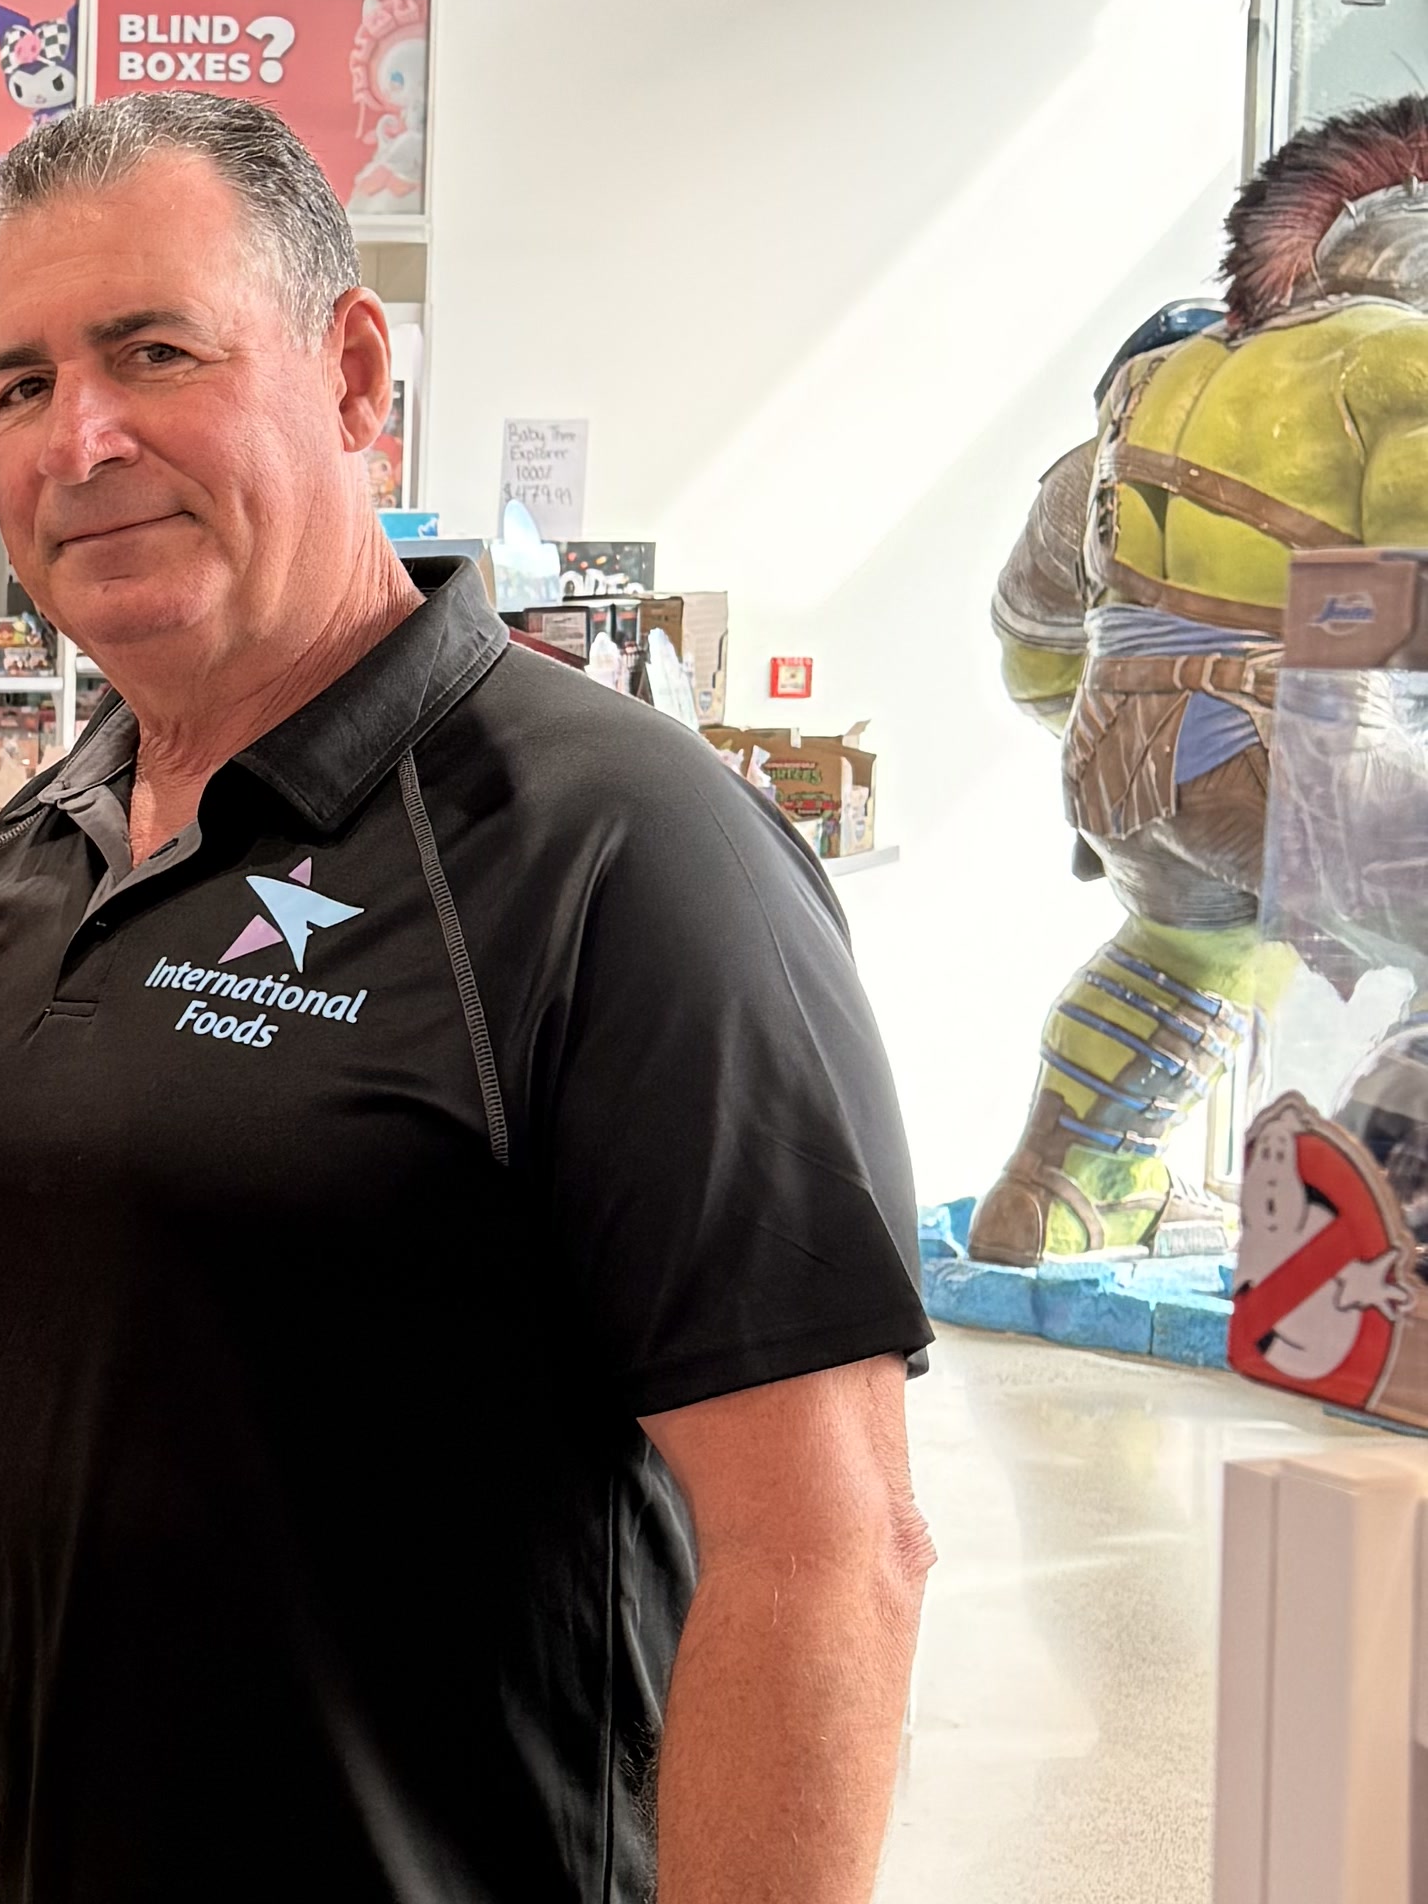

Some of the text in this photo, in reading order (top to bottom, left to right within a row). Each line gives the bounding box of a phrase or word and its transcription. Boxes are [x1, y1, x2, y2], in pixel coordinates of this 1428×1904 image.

[118, 13, 240, 46] BLIND
[143, 956, 368, 1024] International
[174, 1000, 280, 1048] Foods
